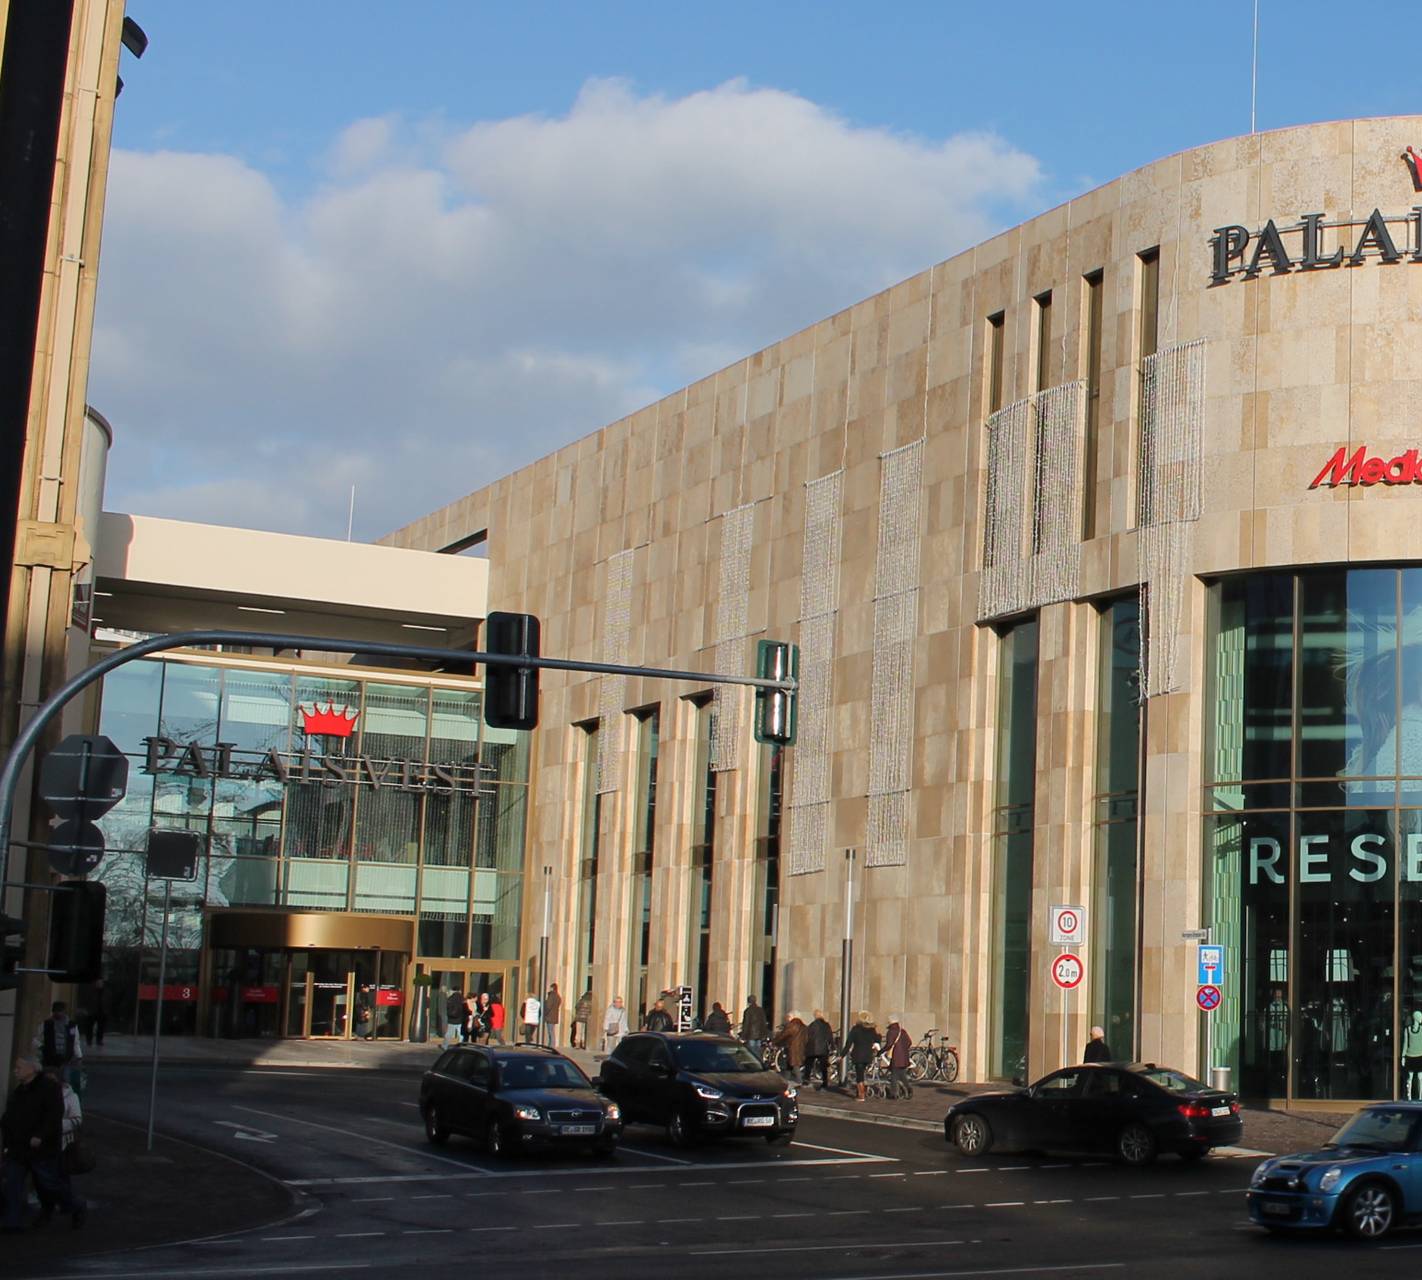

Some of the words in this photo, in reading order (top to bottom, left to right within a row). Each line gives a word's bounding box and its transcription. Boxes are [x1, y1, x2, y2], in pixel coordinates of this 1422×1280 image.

[139, 737, 348, 788] PALAIS
[362, 753, 495, 797] VEST
[1063, 916, 1073, 928] 10
[182, 987, 191, 999] 3
